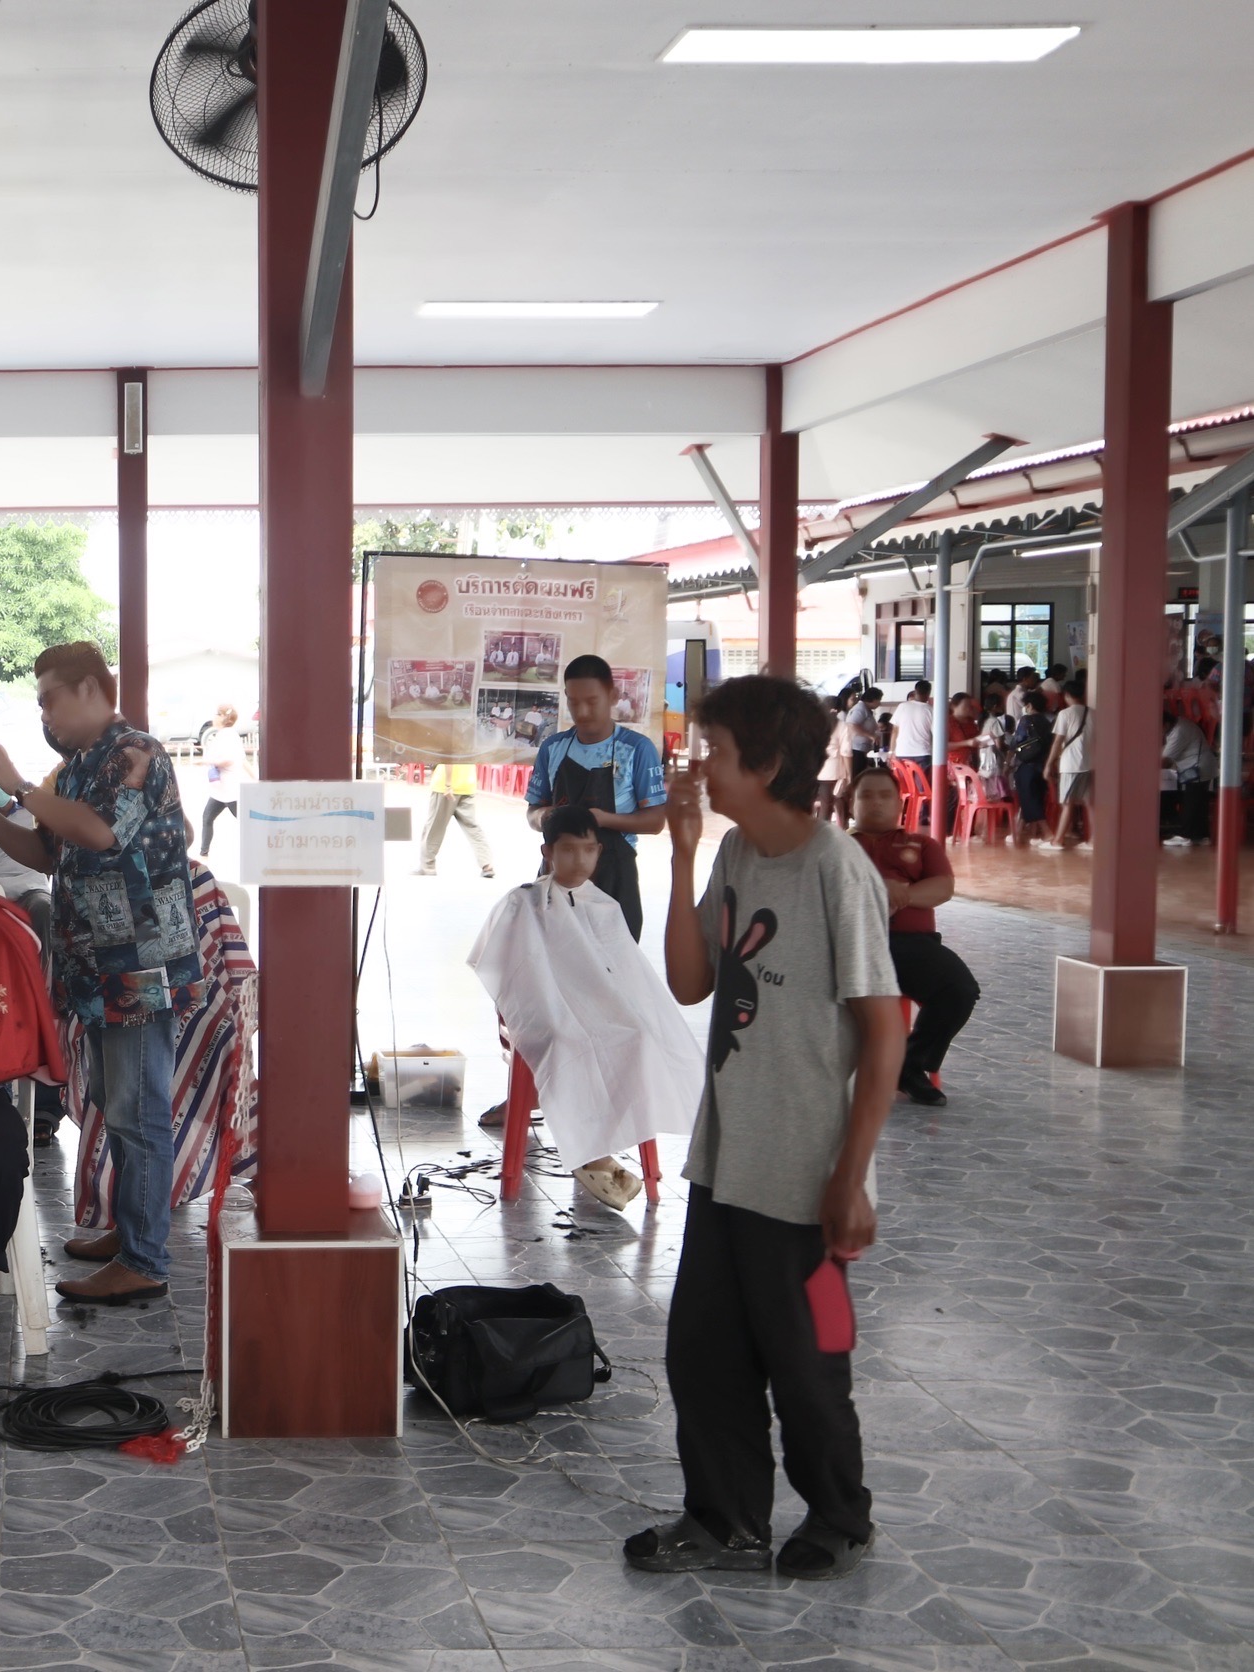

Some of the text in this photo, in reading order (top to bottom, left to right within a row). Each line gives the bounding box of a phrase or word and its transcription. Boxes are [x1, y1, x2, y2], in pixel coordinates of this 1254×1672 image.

[455, 574, 595, 600] บริการตัดผมฟรี
[267, 829, 357, 849] เข้ามาจอด
[756, 963, 784, 986] You
